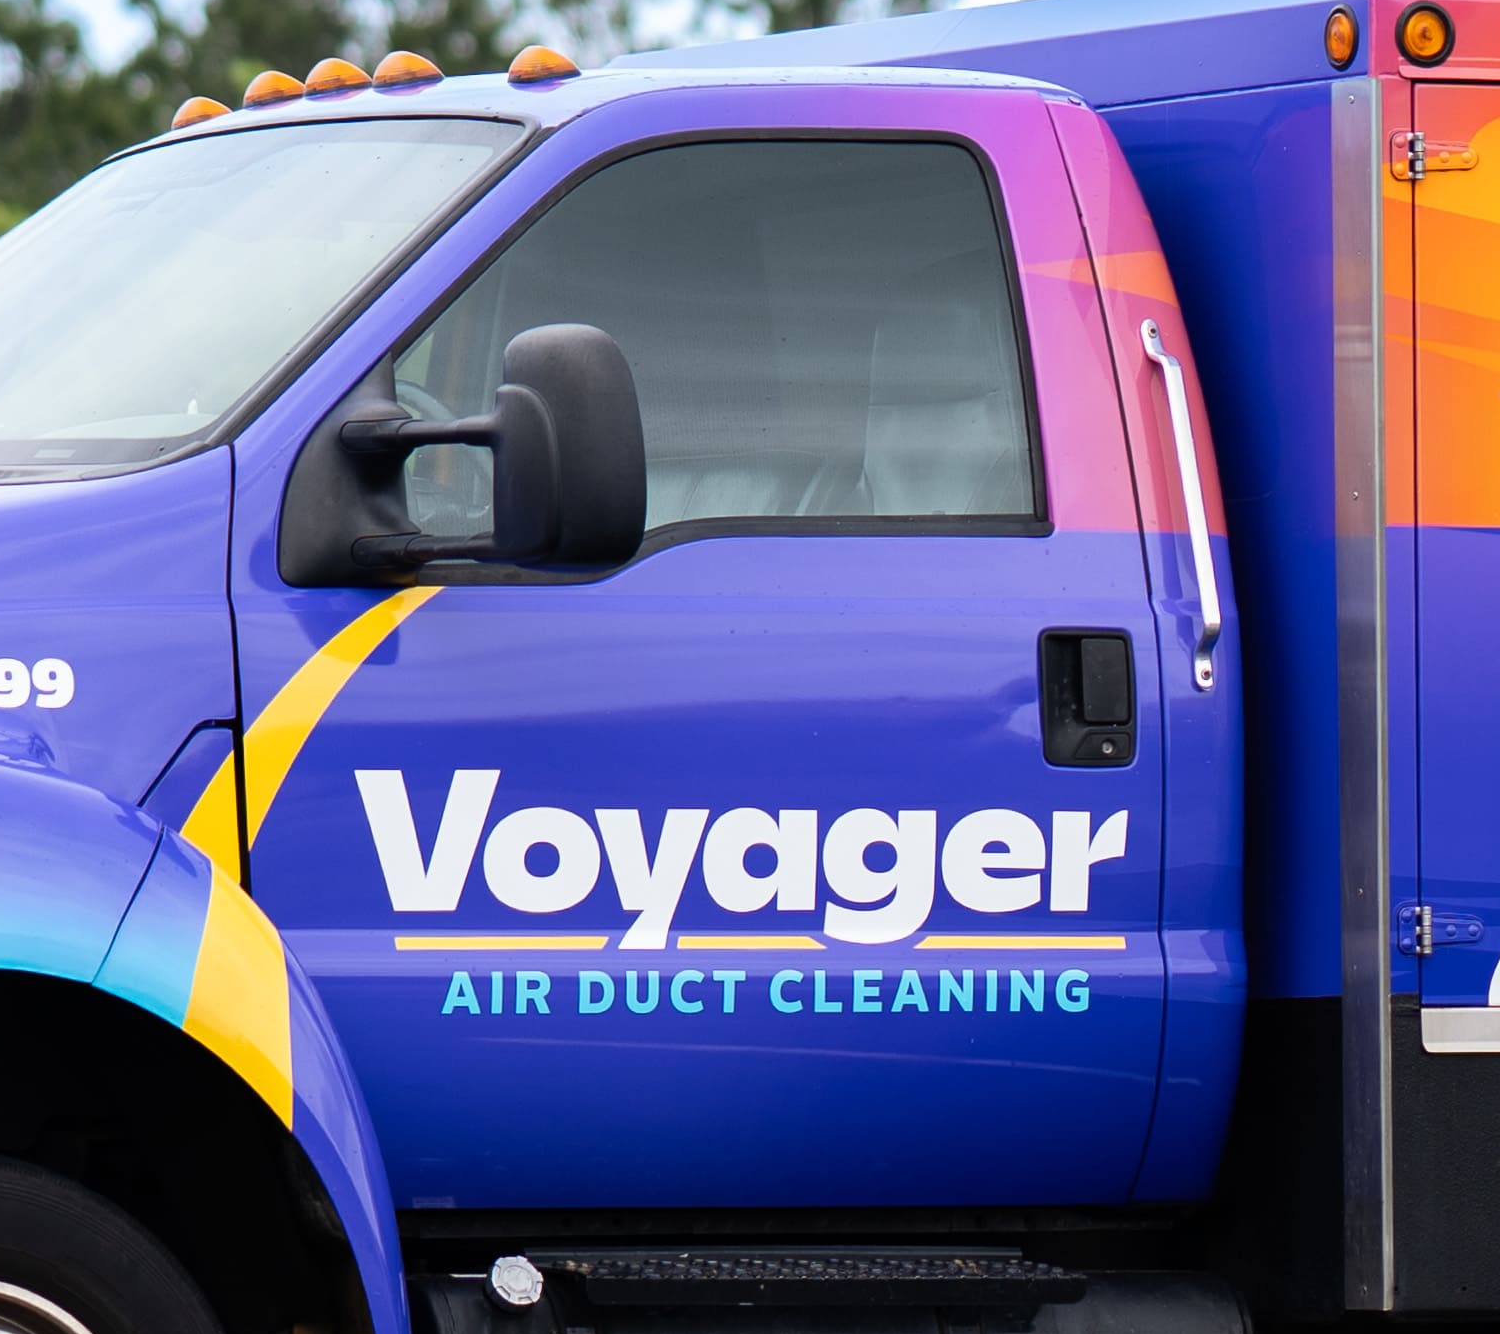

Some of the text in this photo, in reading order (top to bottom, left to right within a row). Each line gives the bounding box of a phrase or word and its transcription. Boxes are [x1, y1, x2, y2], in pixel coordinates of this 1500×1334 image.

[355, 768, 1129, 950] Voyager
[442, 969, 1091, 1015] AIR DUCT CLEANING
